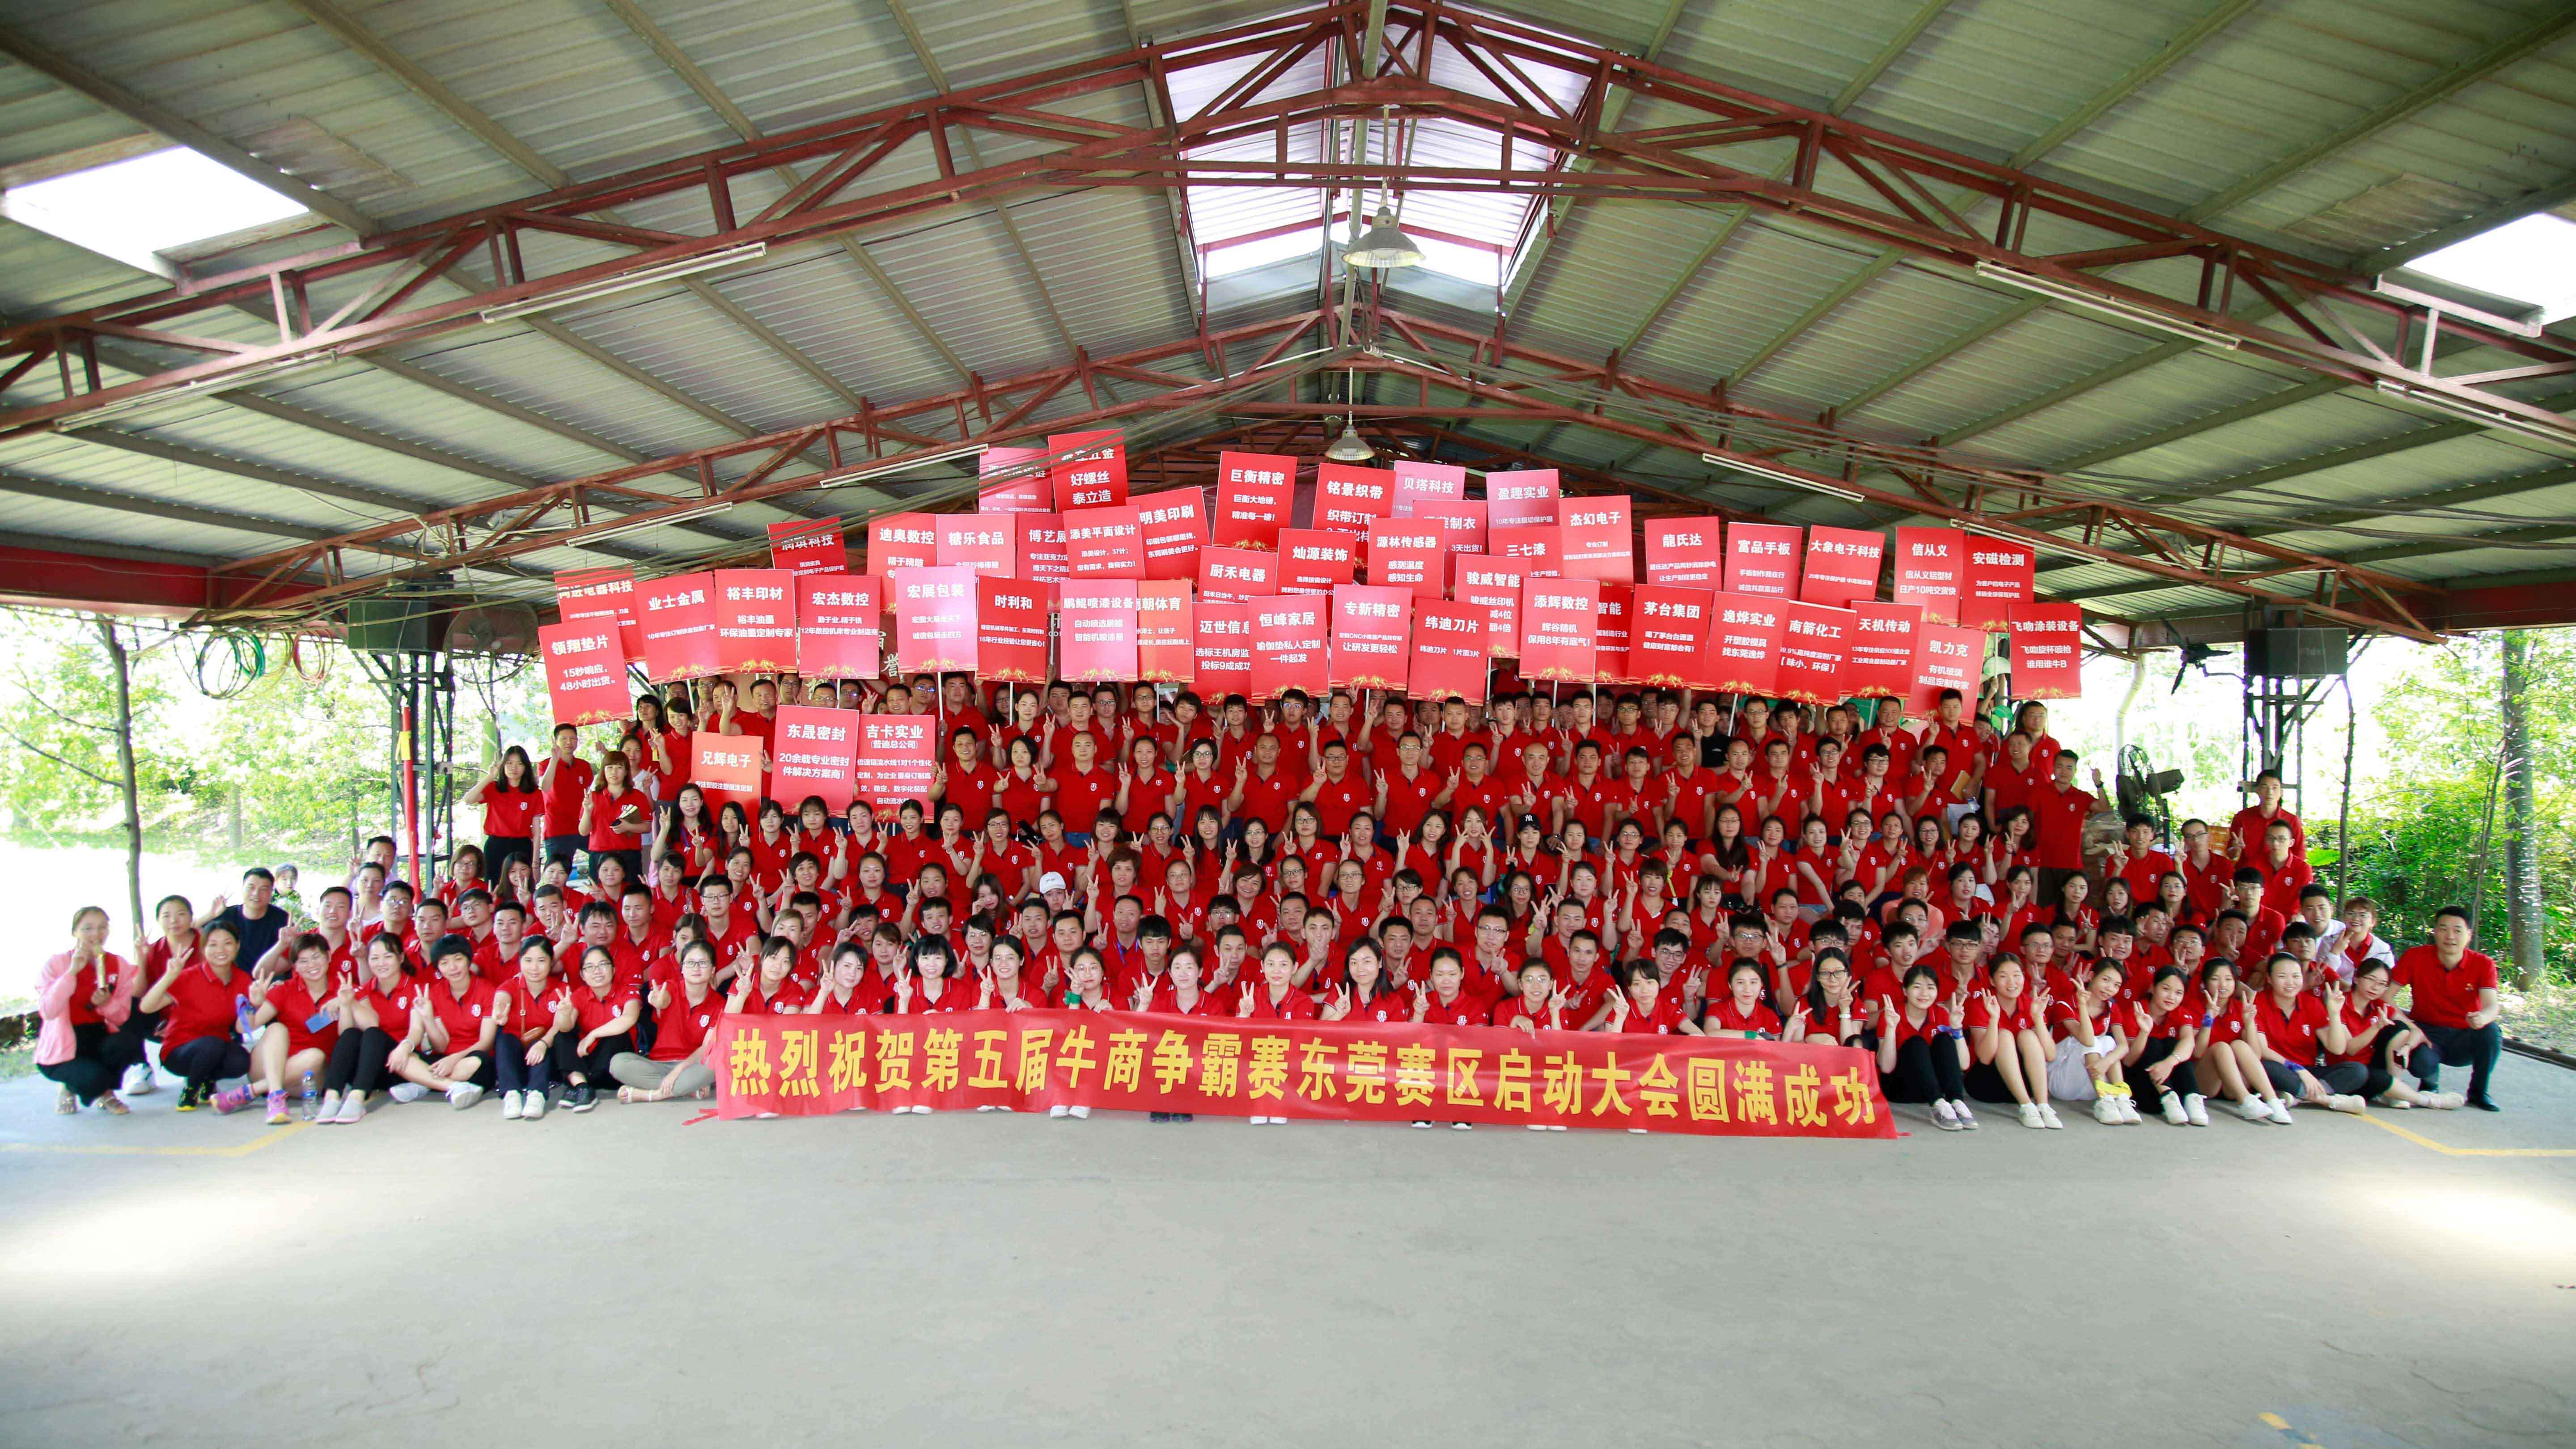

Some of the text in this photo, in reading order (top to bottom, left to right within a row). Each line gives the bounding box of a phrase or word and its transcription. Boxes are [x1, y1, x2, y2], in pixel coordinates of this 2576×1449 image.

[1070, 470, 1110, 486] 好螺丝
[1230, 469, 1285, 486] 巨衡精密
[1327, 480, 1383, 499] 铭景织带
[1403, 476, 1455, 495] 贝塔科技
[1497, 486, 1550, 500] 盈趣实业
[1072, 489, 1112, 505] 泰立造
[1140, 504, 1195, 525] 明美印刷
[1570, 512, 1622, 526] 杰幻电子
[880, 528, 935, 544] 迪奥数控
[949, 531, 1004, 546] 糖乐食品
[1069, 524, 1136, 540] 添美平面设计
[1376, 536, 1436, 549] 源林传感器
[1662, 534, 1703, 548] 龍氏达
[1737, 539, 1791, 555] 富品手板
[1292, 546, 1348, 562] 灿源装饰
[1506, 542, 1546, 557] 三七漆
[1810, 540, 1881, 559] 大象电子科技
[1911, 543, 1948, 558] 信从义
[1388, 560, 1424, 570] 感测温度
[1973, 552, 2025, 567] 安磁检测
[1210, 564, 1266, 583] 厨禾电器
[1388, 572, 1424, 582] 感知生命
[1466, 571, 1521, 587] 骏威智能
[1905, 570, 1953, 580] 信从义铝型材
[726, 587, 784, 601] 裕丰印材
[907, 583, 965, 598] 宏展包装
[1899, 584, 1957, 596] 日产10吨交货快
[648, 589, 705, 611] 业士金属
[812, 592, 869, 607] 宏杰数控
[994, 595, 1033, 610] 时利和
[1063, 597, 1134, 610] 鹏鲲喷漆设备
[1534, 595, 1589, 611] 添辉数控
[1344, 601, 1400, 619] 专新精密
[1644, 601, 1700, 619] 茅台集团
[737, 615, 775, 625] 裕丰油墨
[1259, 612, 1316, 627] 恒峰家居
[1425, 615, 1479, 634] 纬迪刀片
[1722, 609, 1776, 627] 逸烨实业
[1859, 618, 1910, 633] 天机传动
[720, 628, 794, 638] 环保油墨定制专家
[1789, 619, 1842, 639] 南箭化工
[2011, 620, 2079, 632] 飞吻涂装设备
[551, 634, 609, 655] 领翔垫片
[1256, 640, 1321, 651] 瑜伽垫私人定制
[1343, 642, 1398, 654] 让研发更轻松
[1724, 635, 1767, 647] 开塑胶模具
[1929, 640, 1969, 657] 凯力克
[1419, 645, 1448, 654] 纬迪刀片
[1270, 653, 1307, 664] 一件起发
[1918, 675, 1970, 691] 制品定制专家
[787, 724, 847, 742] 东晟密封
[865, 724, 924, 740] 吉卡实业
[701, 751, 752, 768] 兄辉电子
[779, 752, 850, 767] 20余载专业密封
[730, 1025, 1877, 1127] 热烈祝贺第五届牛商争霸赛东莞赛区启动大会圆满成功
